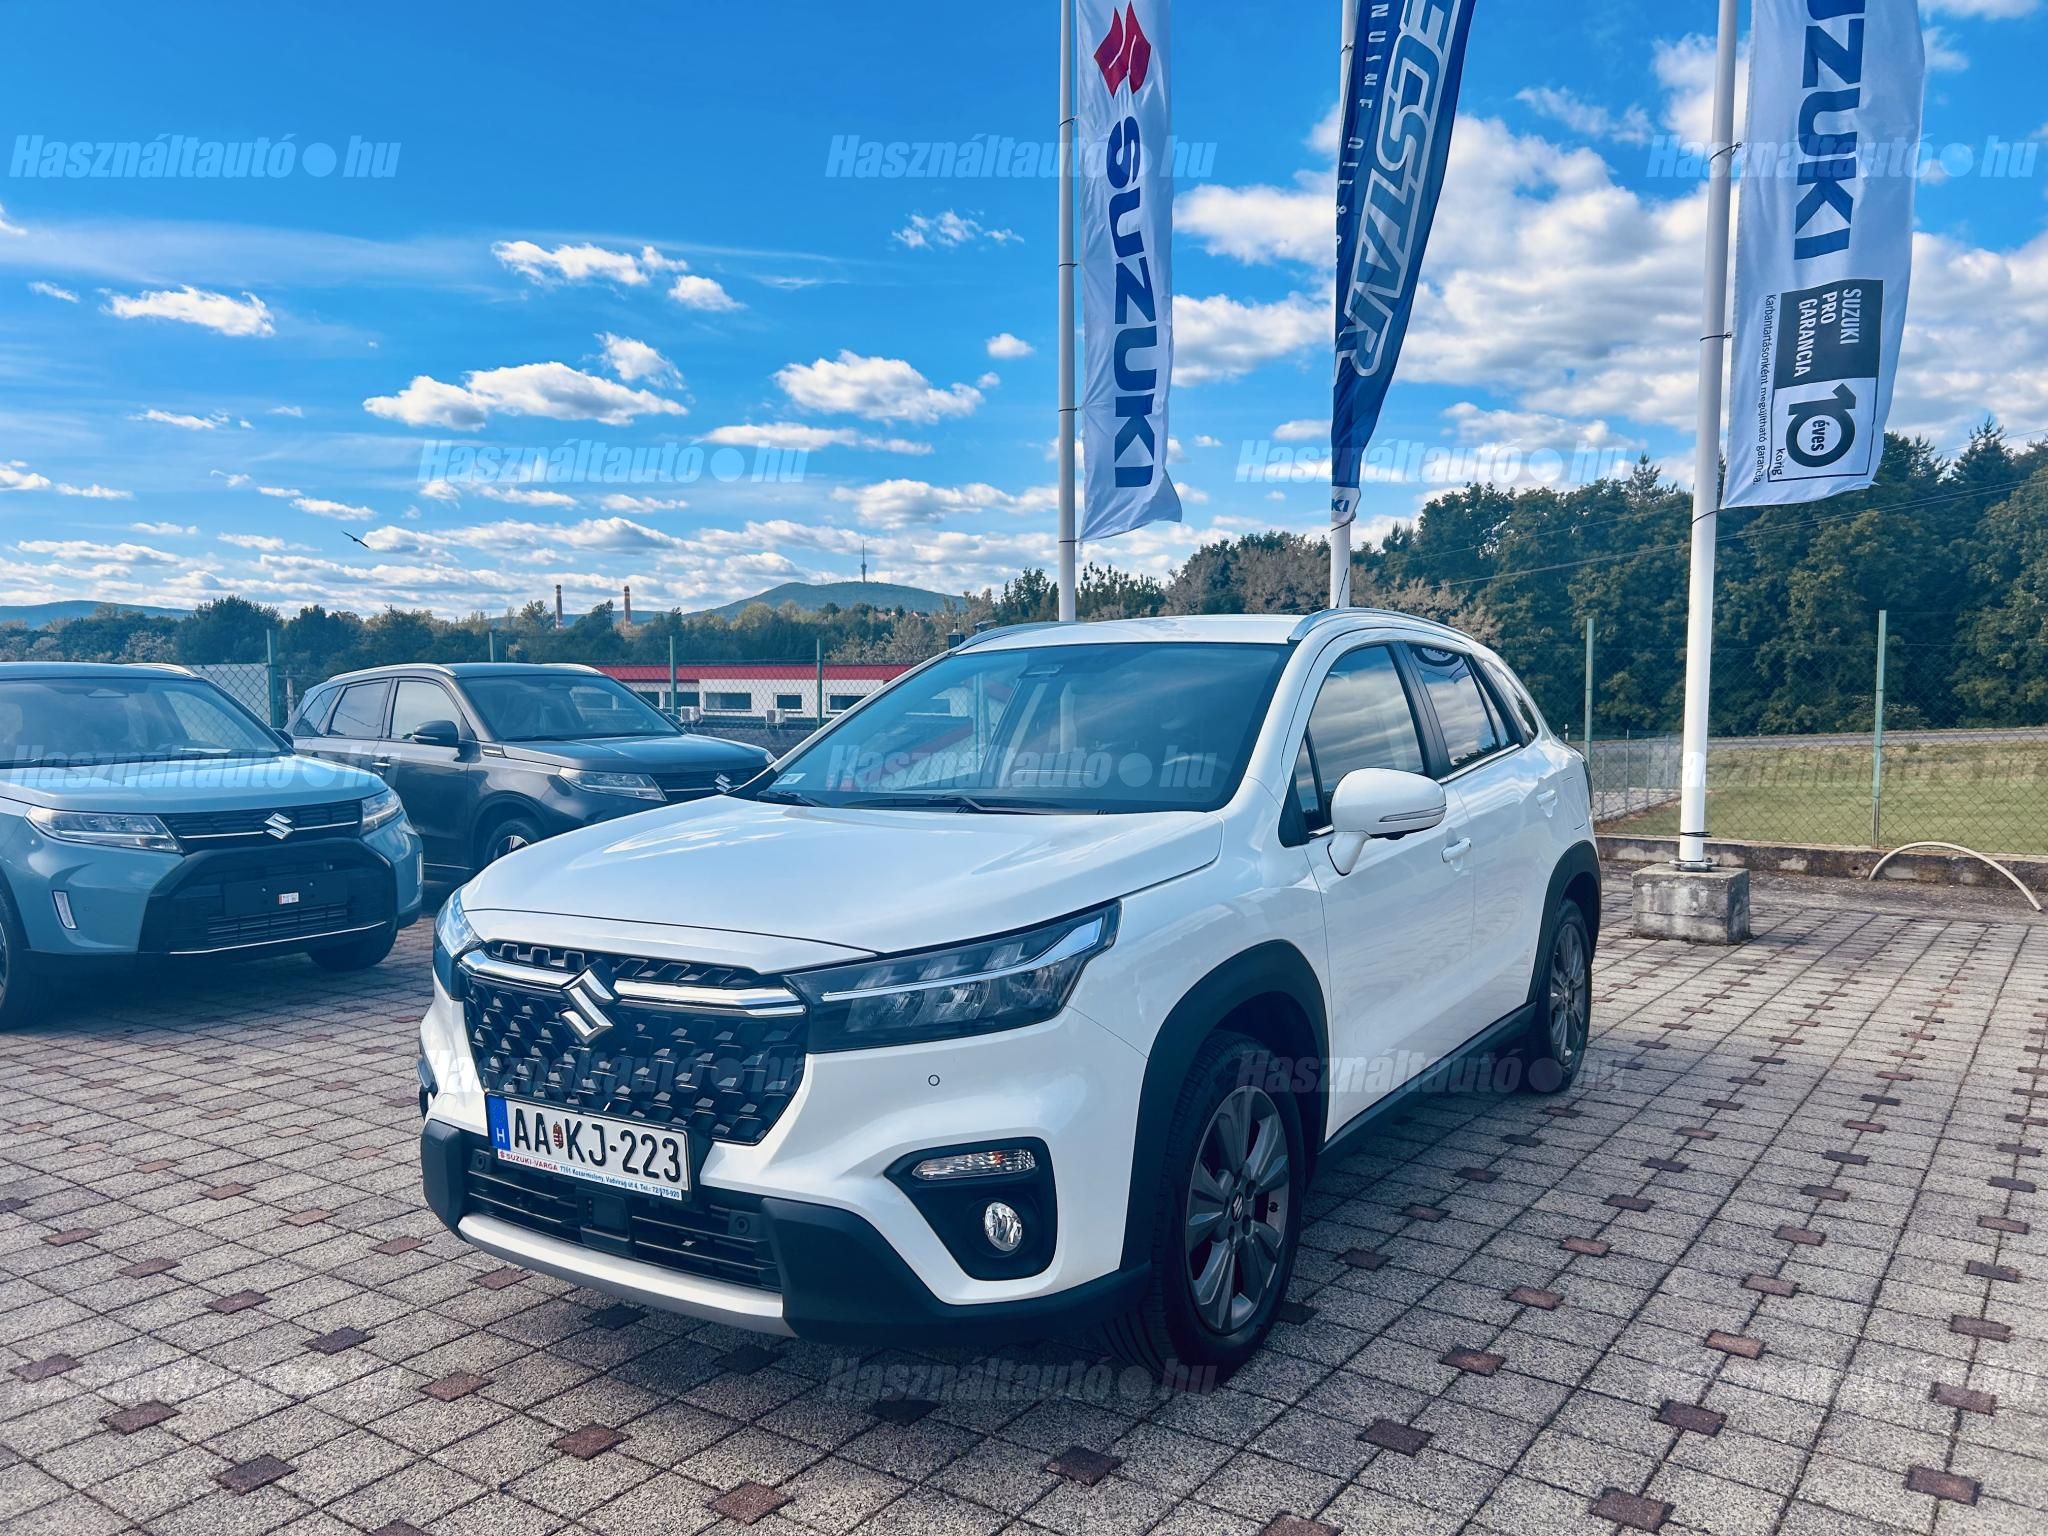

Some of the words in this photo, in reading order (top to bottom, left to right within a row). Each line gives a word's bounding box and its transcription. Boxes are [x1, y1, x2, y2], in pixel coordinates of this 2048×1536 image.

[1106, 115, 1158, 488] SUZUKI
[1821, 291, 1838, 324] PRO
[1840, 288, 1862, 345] SUZUKI
[1760, 294, 1776, 385] Karbantartásonként
[1793, 298, 1817, 377] GARANCIA
[1758, 387, 1768, 442] megújítható
[1786, 383, 1857, 468] 10
[1811, 419, 1826, 452] éves
[1772, 448, 1786, 476] korig
[496, 1128, 505, 1143] H
[506, 1153, 558, 1171] SUZUKI-VARGA
[514, 1108, 551, 1155] AA
[564, 1118, 681, 1183] KJ-223
